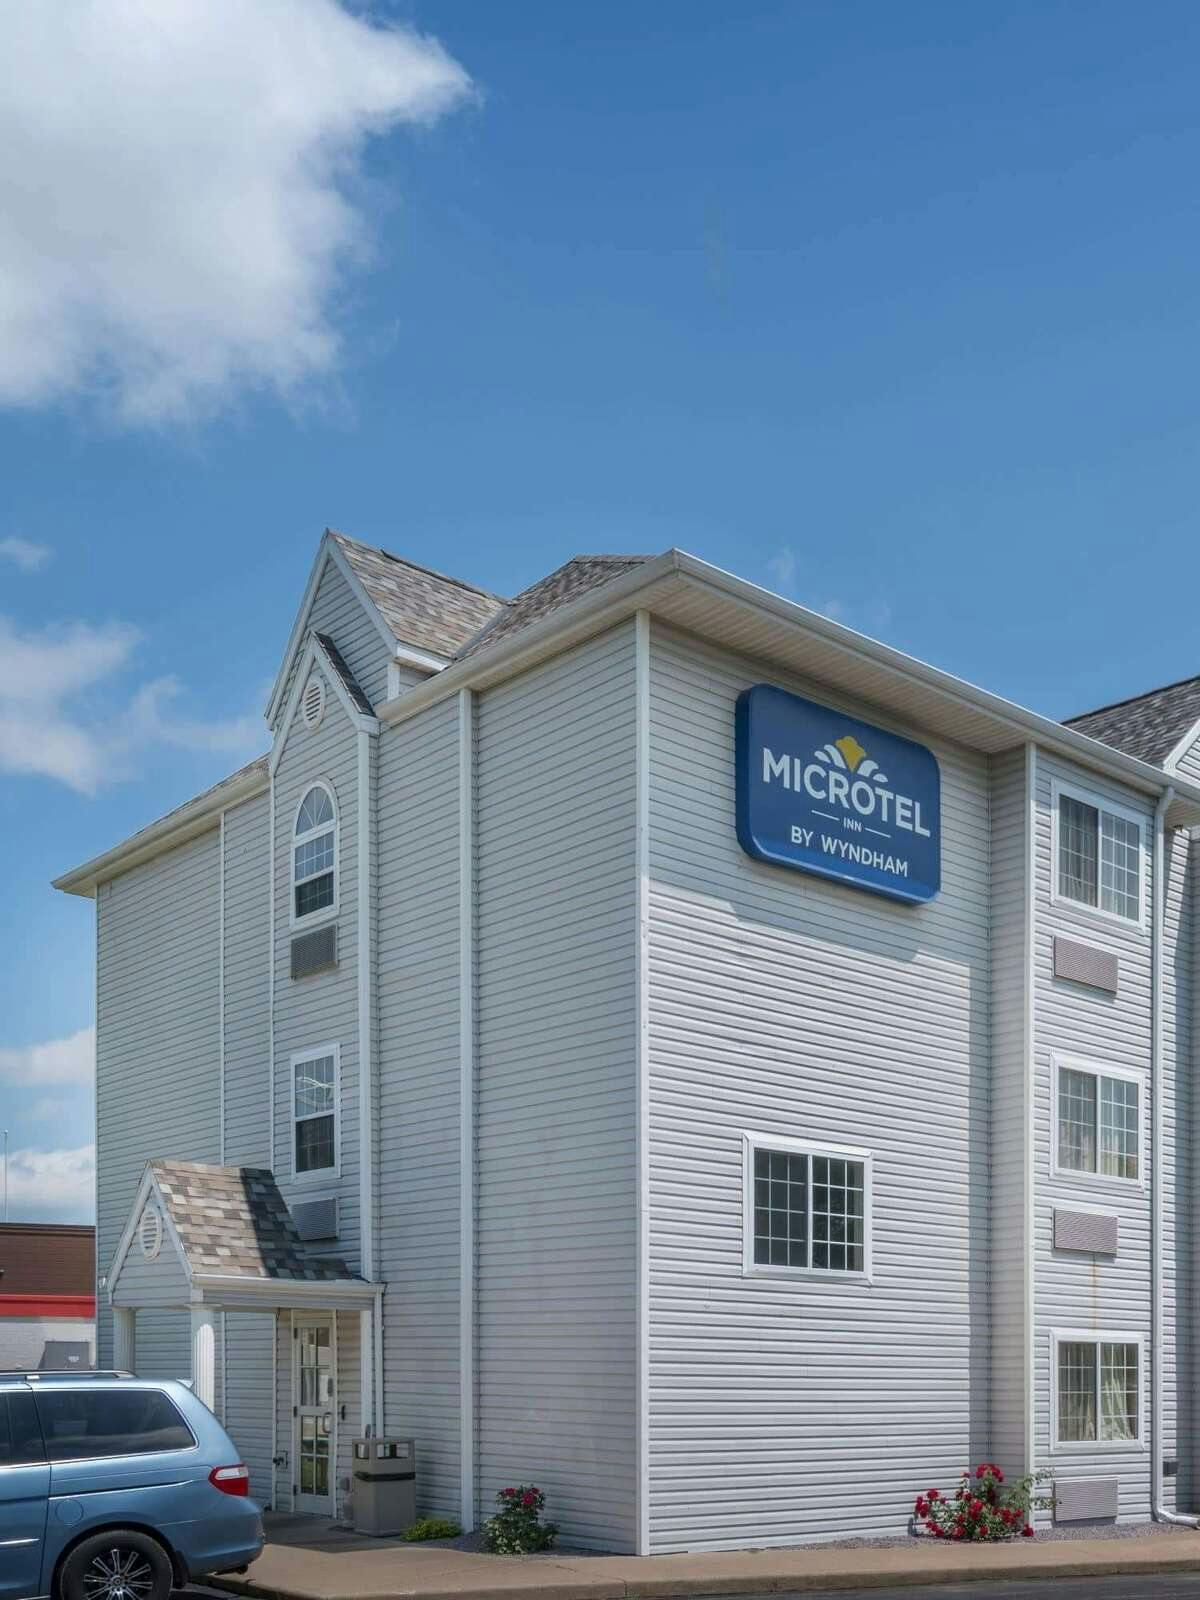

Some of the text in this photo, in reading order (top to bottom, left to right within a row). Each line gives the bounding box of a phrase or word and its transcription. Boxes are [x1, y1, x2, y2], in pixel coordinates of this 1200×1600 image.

[763, 748, 930, 837] MICROTEL
[844, 817, 862, 832] INN
[791, 825, 908, 877] BY WYNDHAM
